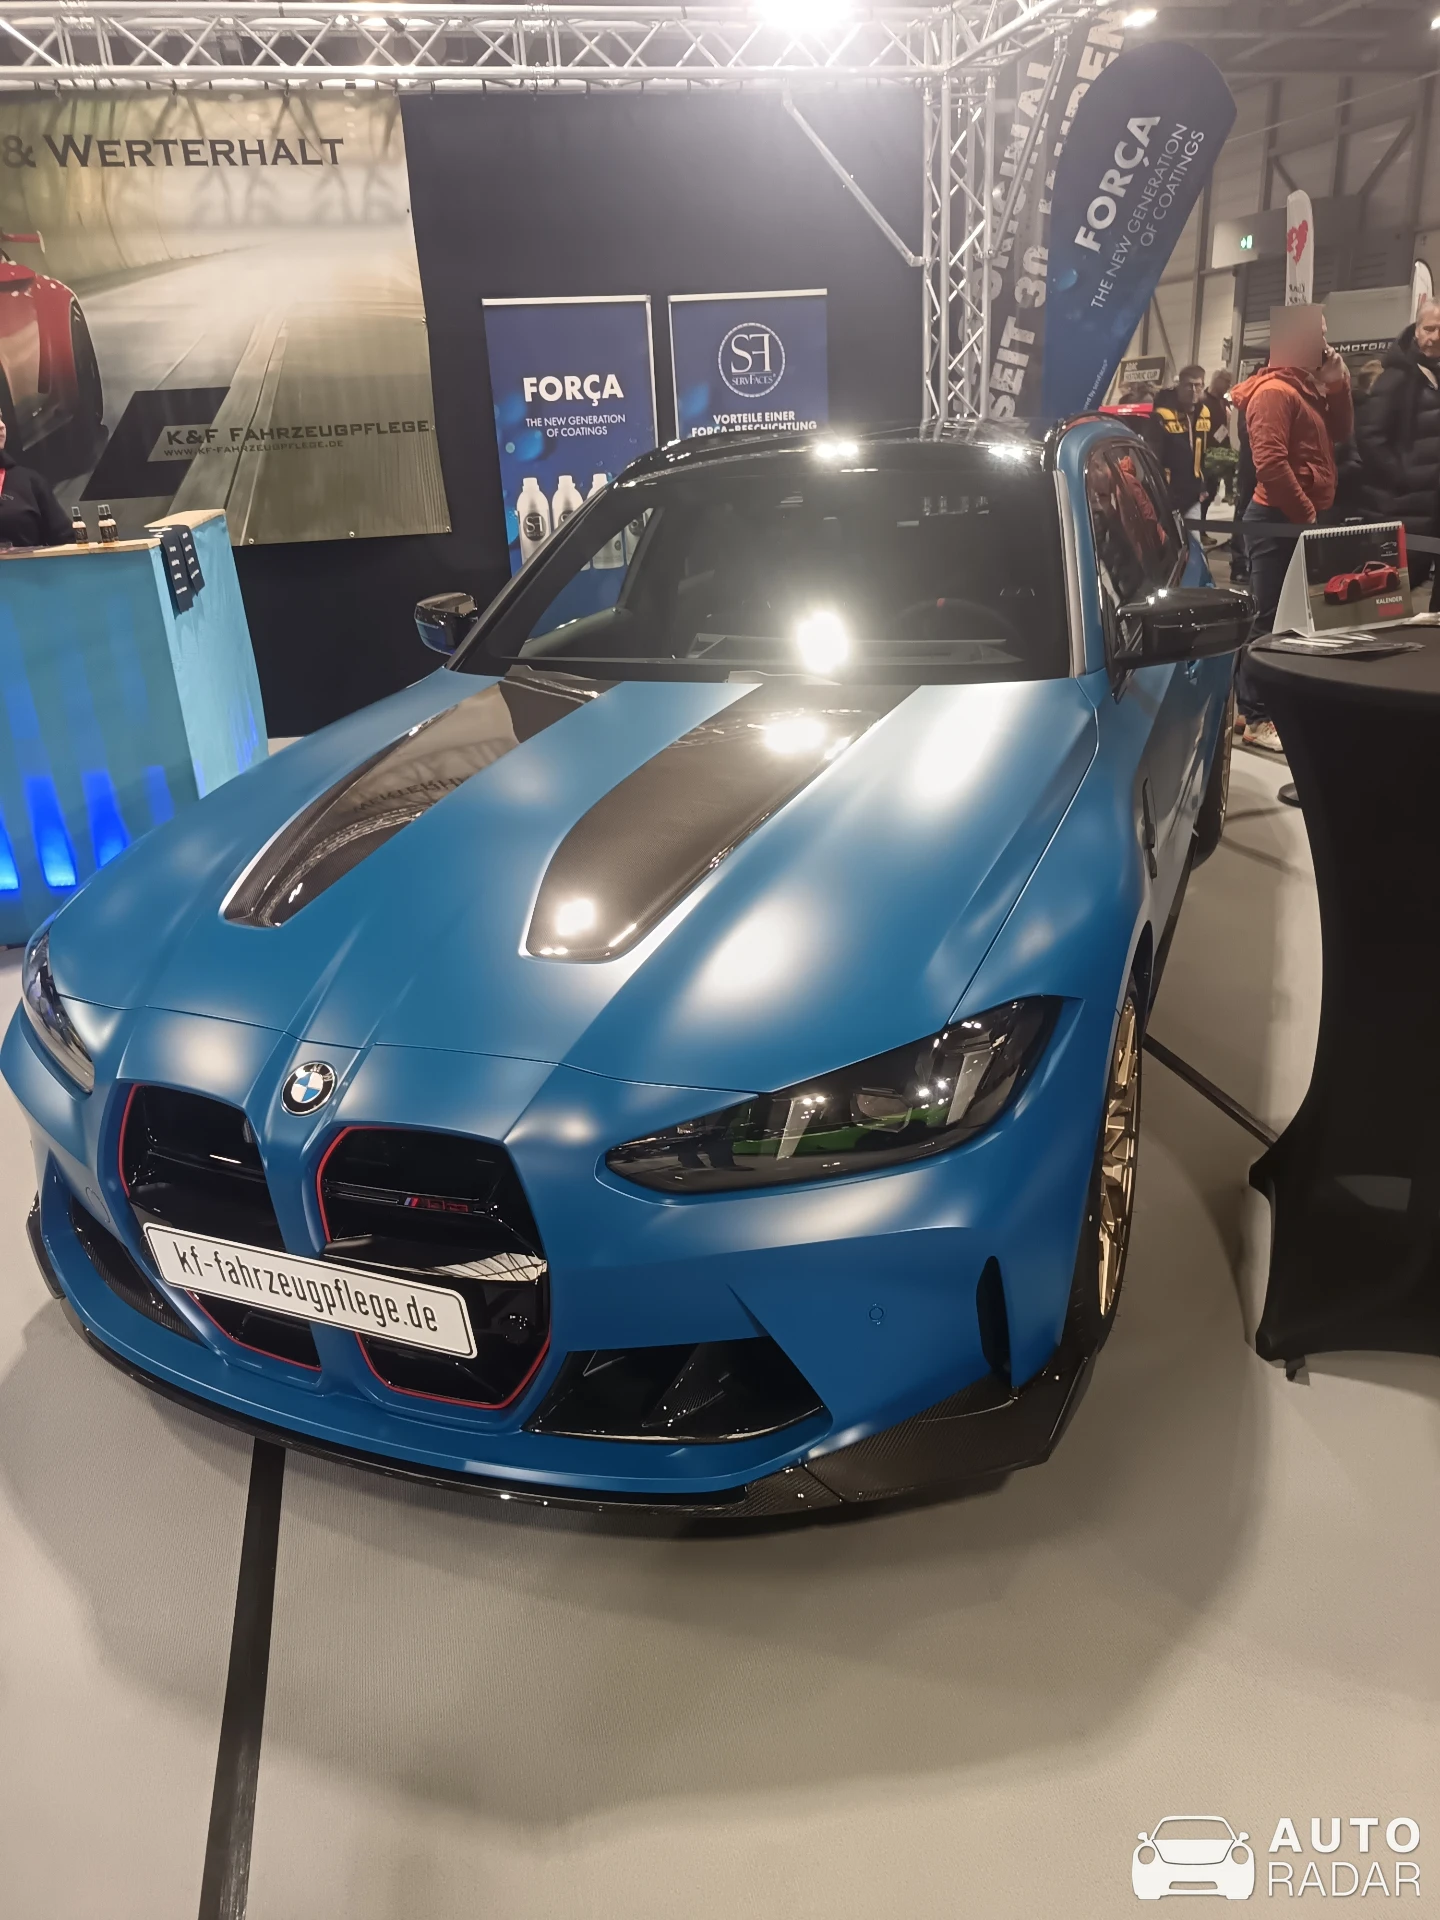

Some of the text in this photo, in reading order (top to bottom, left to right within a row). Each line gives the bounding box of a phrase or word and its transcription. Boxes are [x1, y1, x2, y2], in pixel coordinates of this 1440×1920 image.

[2, 134, 344, 168] & WERTERHALT
[1074, 115, 1161, 253] FORÇA
[1140, 130, 1205, 247] OF COATINGS
[1090, 123, 1188, 309] THE NEW GENERATION
[989, 315, 1036, 420] SEIT
[523, 374, 625, 406] FORÇA
[166, 420, 430, 446] K&F FAHRZEUGPFLEGE
[525, 414, 626, 428] THE NEW GENERATION
[546, 426, 608, 438] OF COATINGS
[713, 411, 795, 425] VORTEILE EINER
[1375, 595, 1403, 605] KALENDER
[172, 1240, 439, 1333] kf-fahrzeugpflege.de
